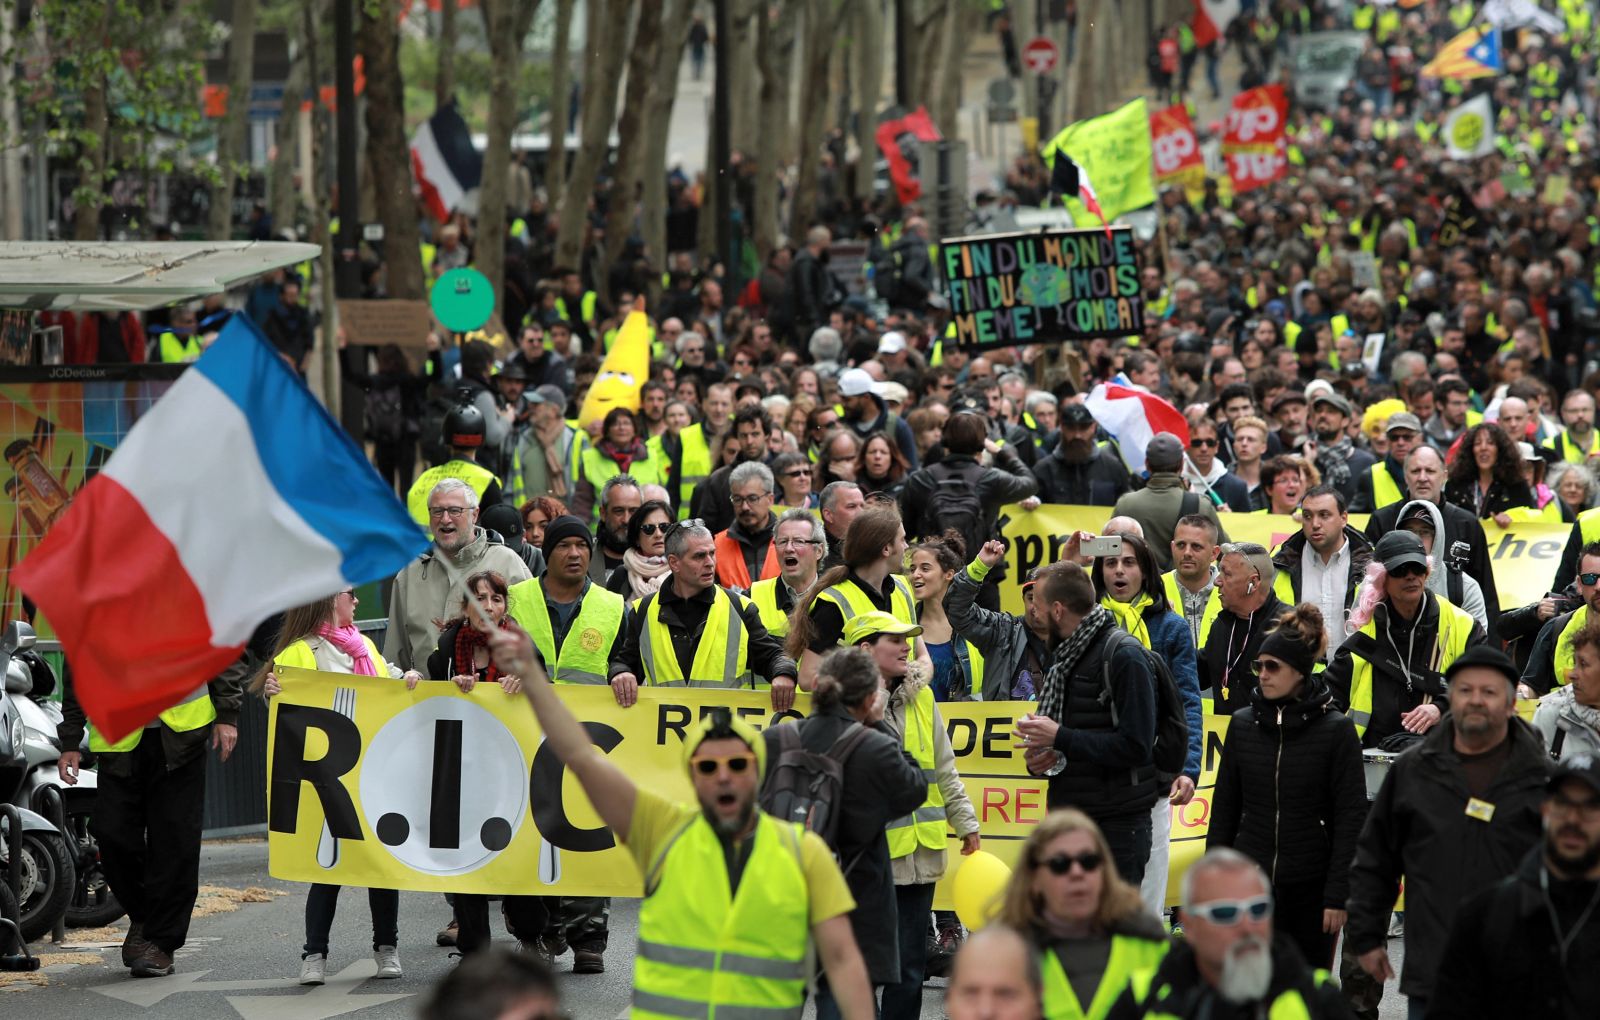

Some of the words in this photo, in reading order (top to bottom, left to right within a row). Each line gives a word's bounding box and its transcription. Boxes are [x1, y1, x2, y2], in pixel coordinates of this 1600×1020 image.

[944, 242, 993, 279] FIN
[996, 238, 1036, 274] DU
[1043, 233, 1134, 269] MONDE
[950, 278, 986, 313] FIN
[986, 274, 1016, 308] DU
[1072, 264, 1140, 298] MOIS
[955, 306, 1034, 345] MEME
[1066, 296, 1143, 333] COMBAT
[49, 367, 106, 378] JCDecaux
[1488, 533, 1562, 560] he
[982, 787, 1049, 824] RE
